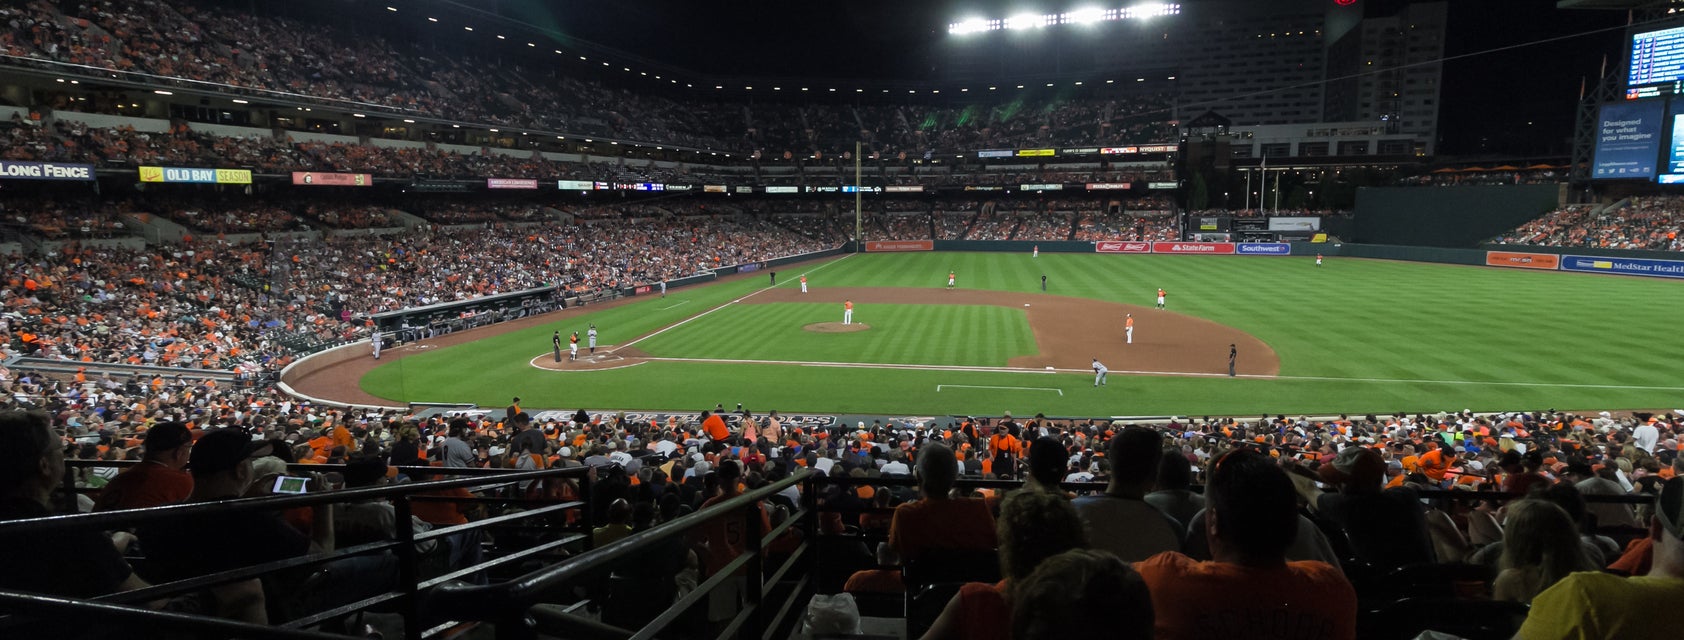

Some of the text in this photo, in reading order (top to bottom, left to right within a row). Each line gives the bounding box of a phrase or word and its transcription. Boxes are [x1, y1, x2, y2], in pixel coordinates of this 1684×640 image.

[1603, 118, 1642, 127] Designed
[0, 162, 89, 178] LONG FENCE
[167, 169, 190, 181] OLD
[191, 170, 213, 182] BAY
[219, 171, 249, 182] SEASON
